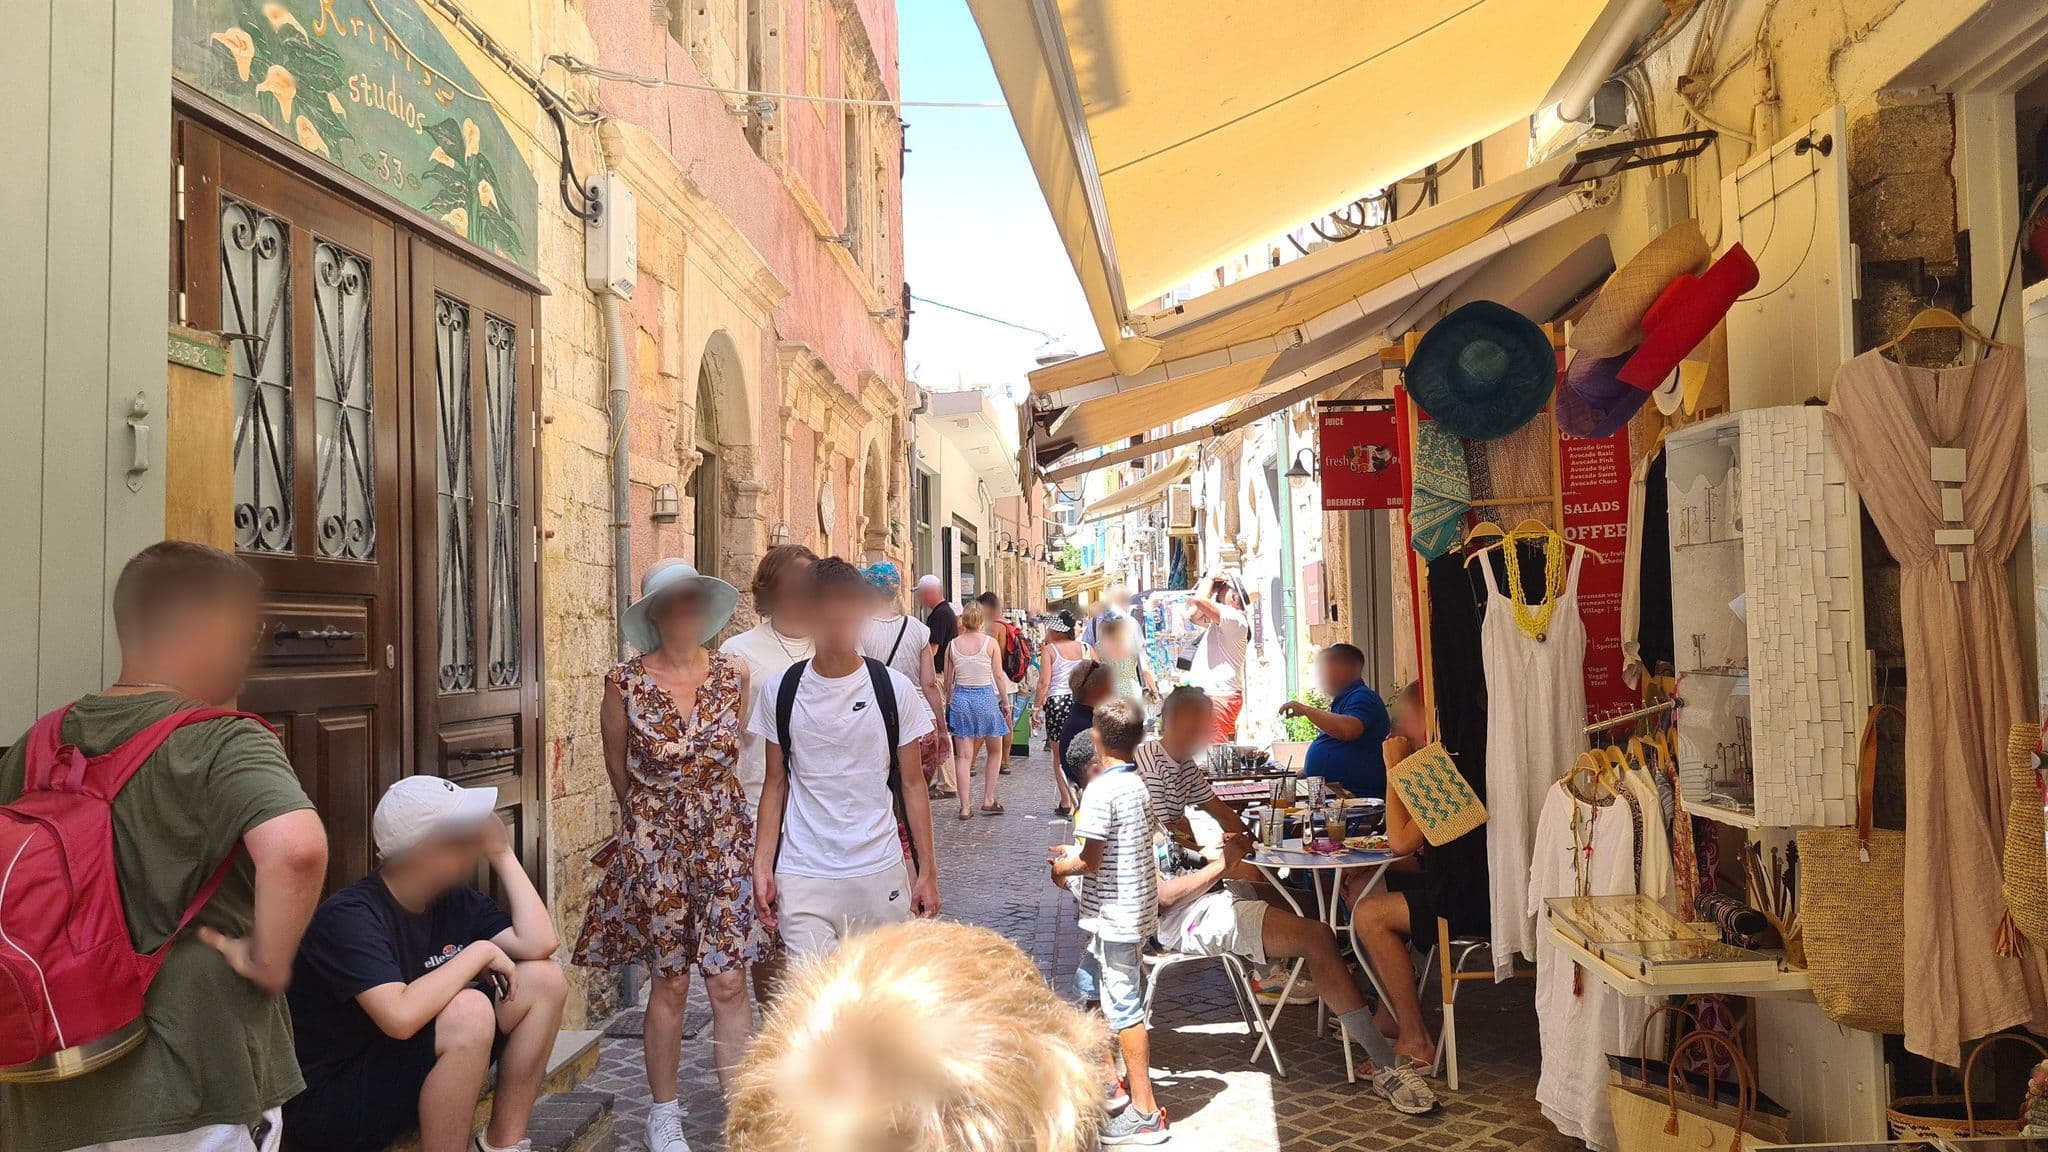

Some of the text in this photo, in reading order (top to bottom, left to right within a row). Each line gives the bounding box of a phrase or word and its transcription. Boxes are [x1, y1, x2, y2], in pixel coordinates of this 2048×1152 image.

[349, 73, 426, 135] studios
[377, 150, 404, 190] 33
[1325, 417, 1344, 426] JUICE
[1325, 455, 1350, 466] fresh
[1326, 497, 1404, 507] BREAKFAST BRU
[1563, 501, 1620, 514] SALADS
[1564, 523, 1627, 540] OFFEE
